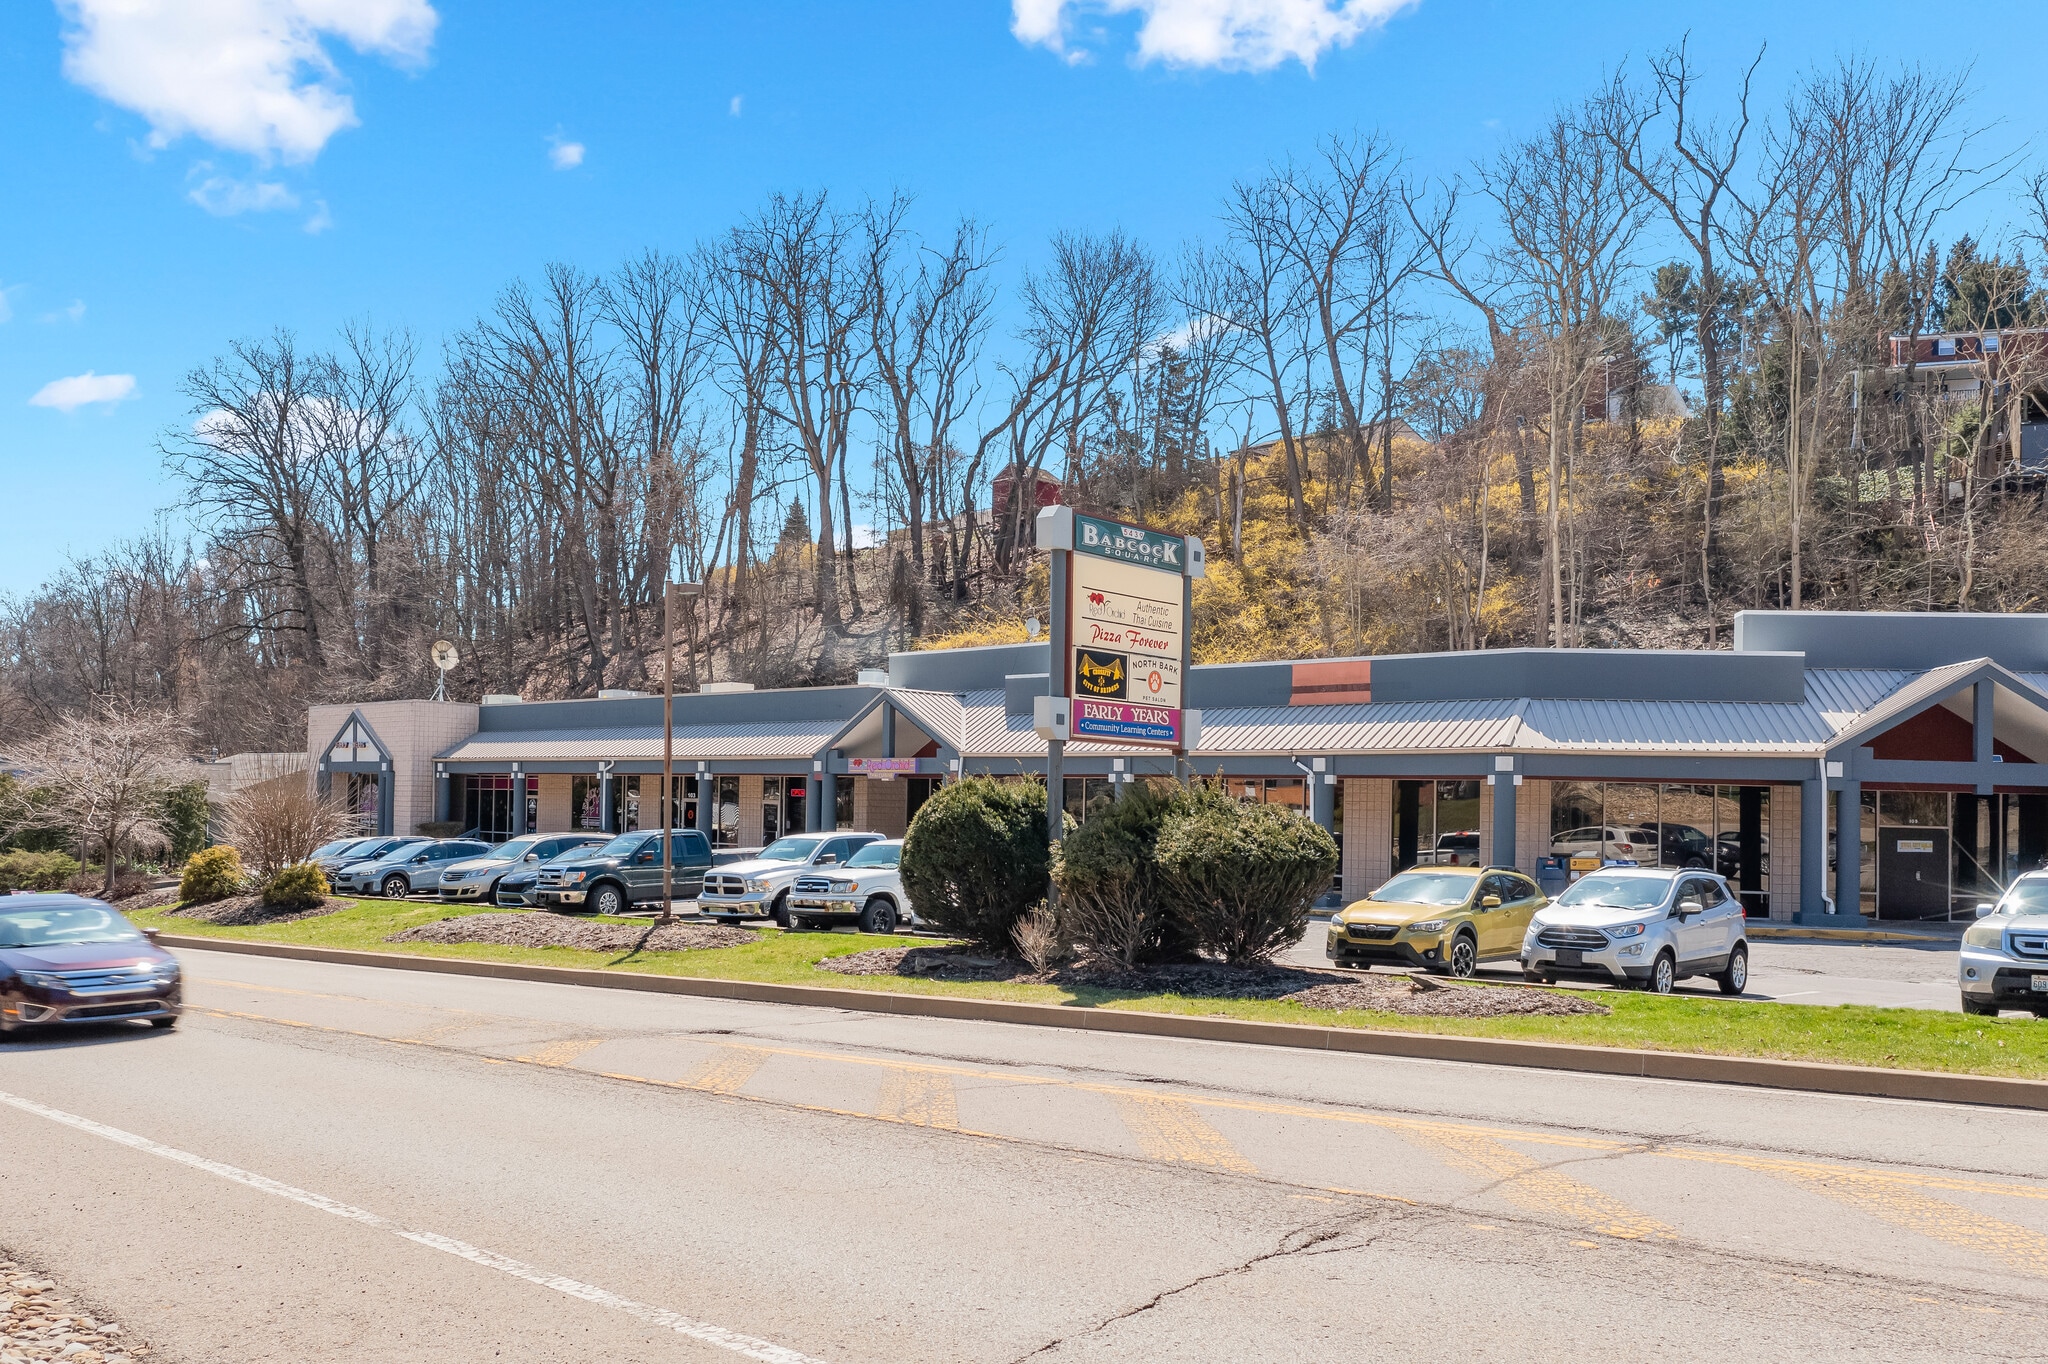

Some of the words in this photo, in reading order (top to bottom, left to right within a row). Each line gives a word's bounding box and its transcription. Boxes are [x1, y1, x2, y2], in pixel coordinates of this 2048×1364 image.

[1123, 528, 1144, 539] 5439
[1081, 521, 1181, 566] BABCOCK
[1089, 603, 1103, 617] Red
[1106, 606, 1126, 619] Orchid
[1136, 601, 1169, 617] Authentic
[1132, 612, 1146, 625] Thai
[1147, 615, 1173, 630] Cuisine
[1090, 624, 1122, 643] Pizza
[1125, 630, 1169, 650] Forever
[1132, 660, 1157, 669] NORTH
[1159, 662, 1179, 675] BARK
[1082, 679, 1093, 690] CITY
[1083, 703, 1124, 720] EARLY
[1130, 707, 1170, 725] YEARS
[1085, 722, 1120, 733] Community
[1120, 725, 1147, 736] Learning
[1147, 727, 1169, 737] Centers
